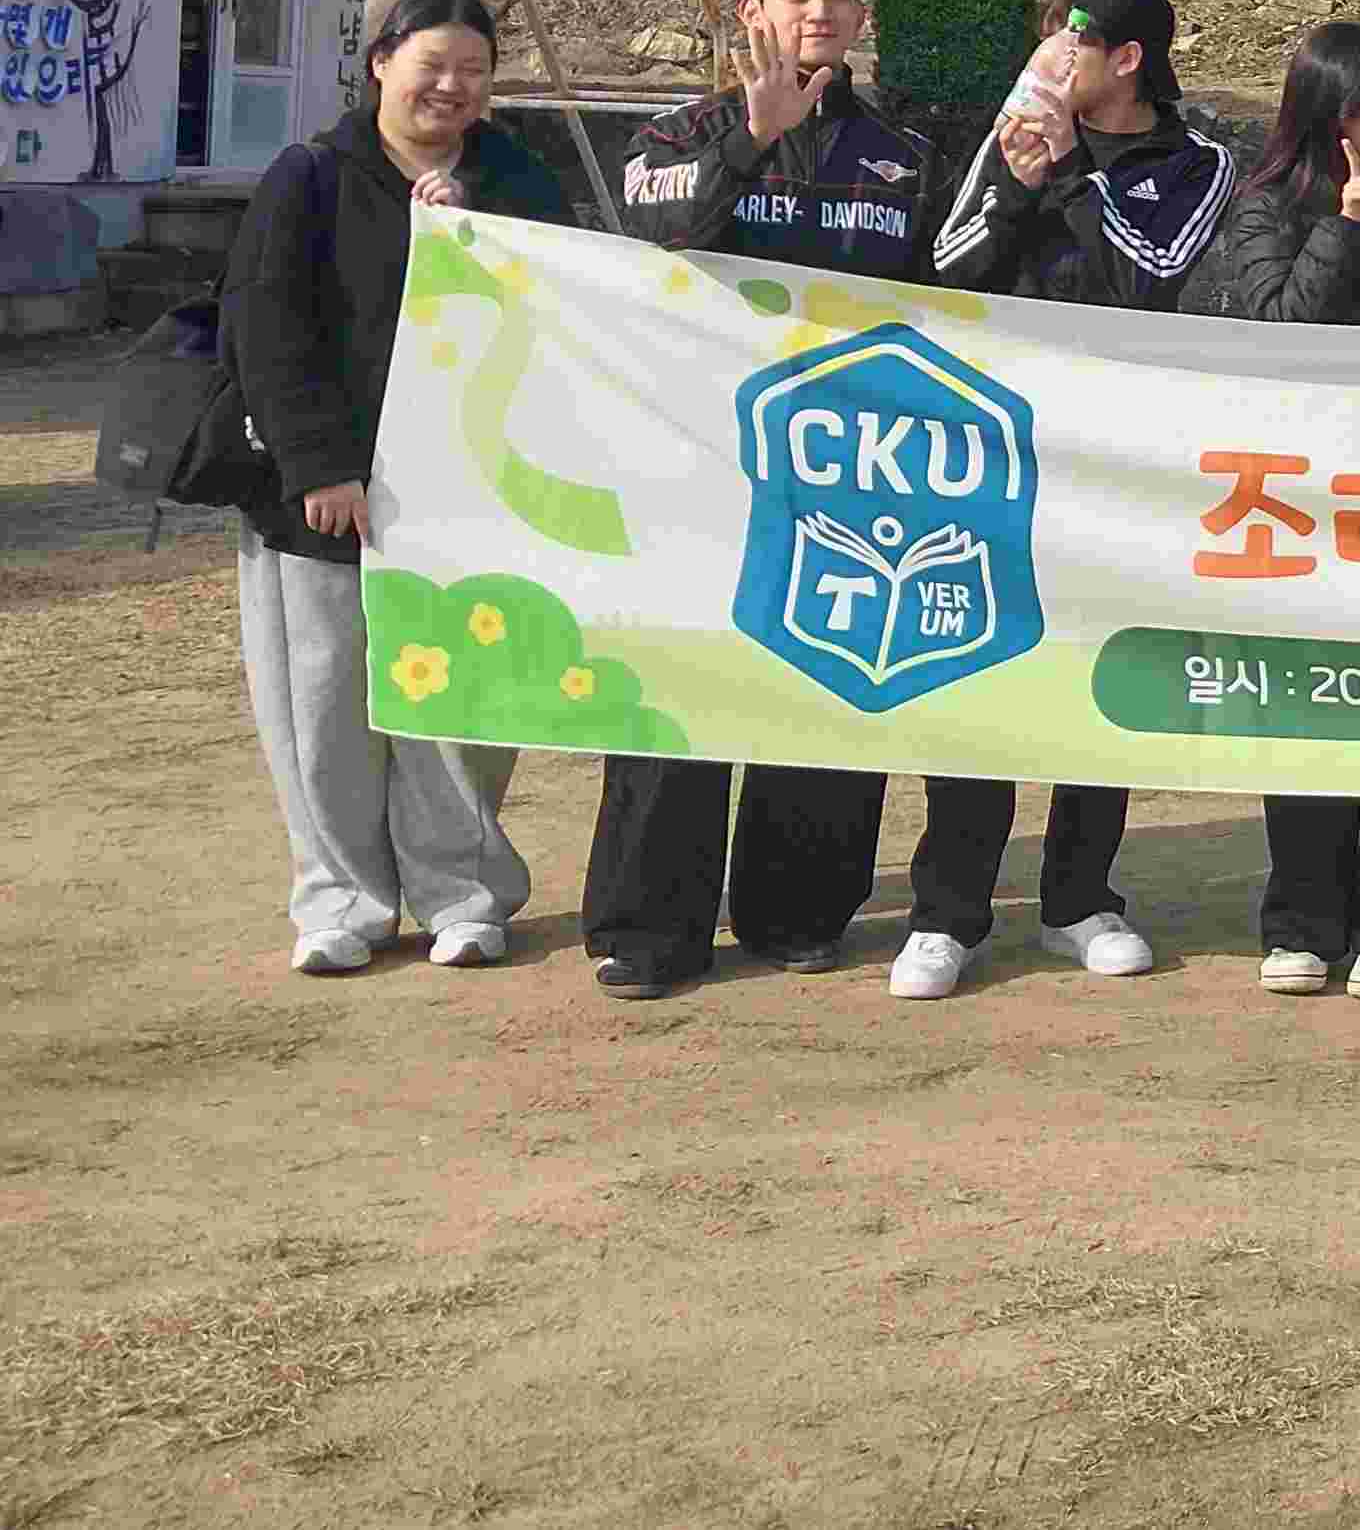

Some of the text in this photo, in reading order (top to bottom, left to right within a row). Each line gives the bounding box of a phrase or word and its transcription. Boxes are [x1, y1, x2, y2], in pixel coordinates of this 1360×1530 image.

[732, 193, 907, 238] ARLEY- DAVIDSON
[788, 409, 985, 498] CKU
[917, 580, 971, 609] VER
[919, 607, 966, 638] UM
[1184, 655, 1269, 706] 일시
